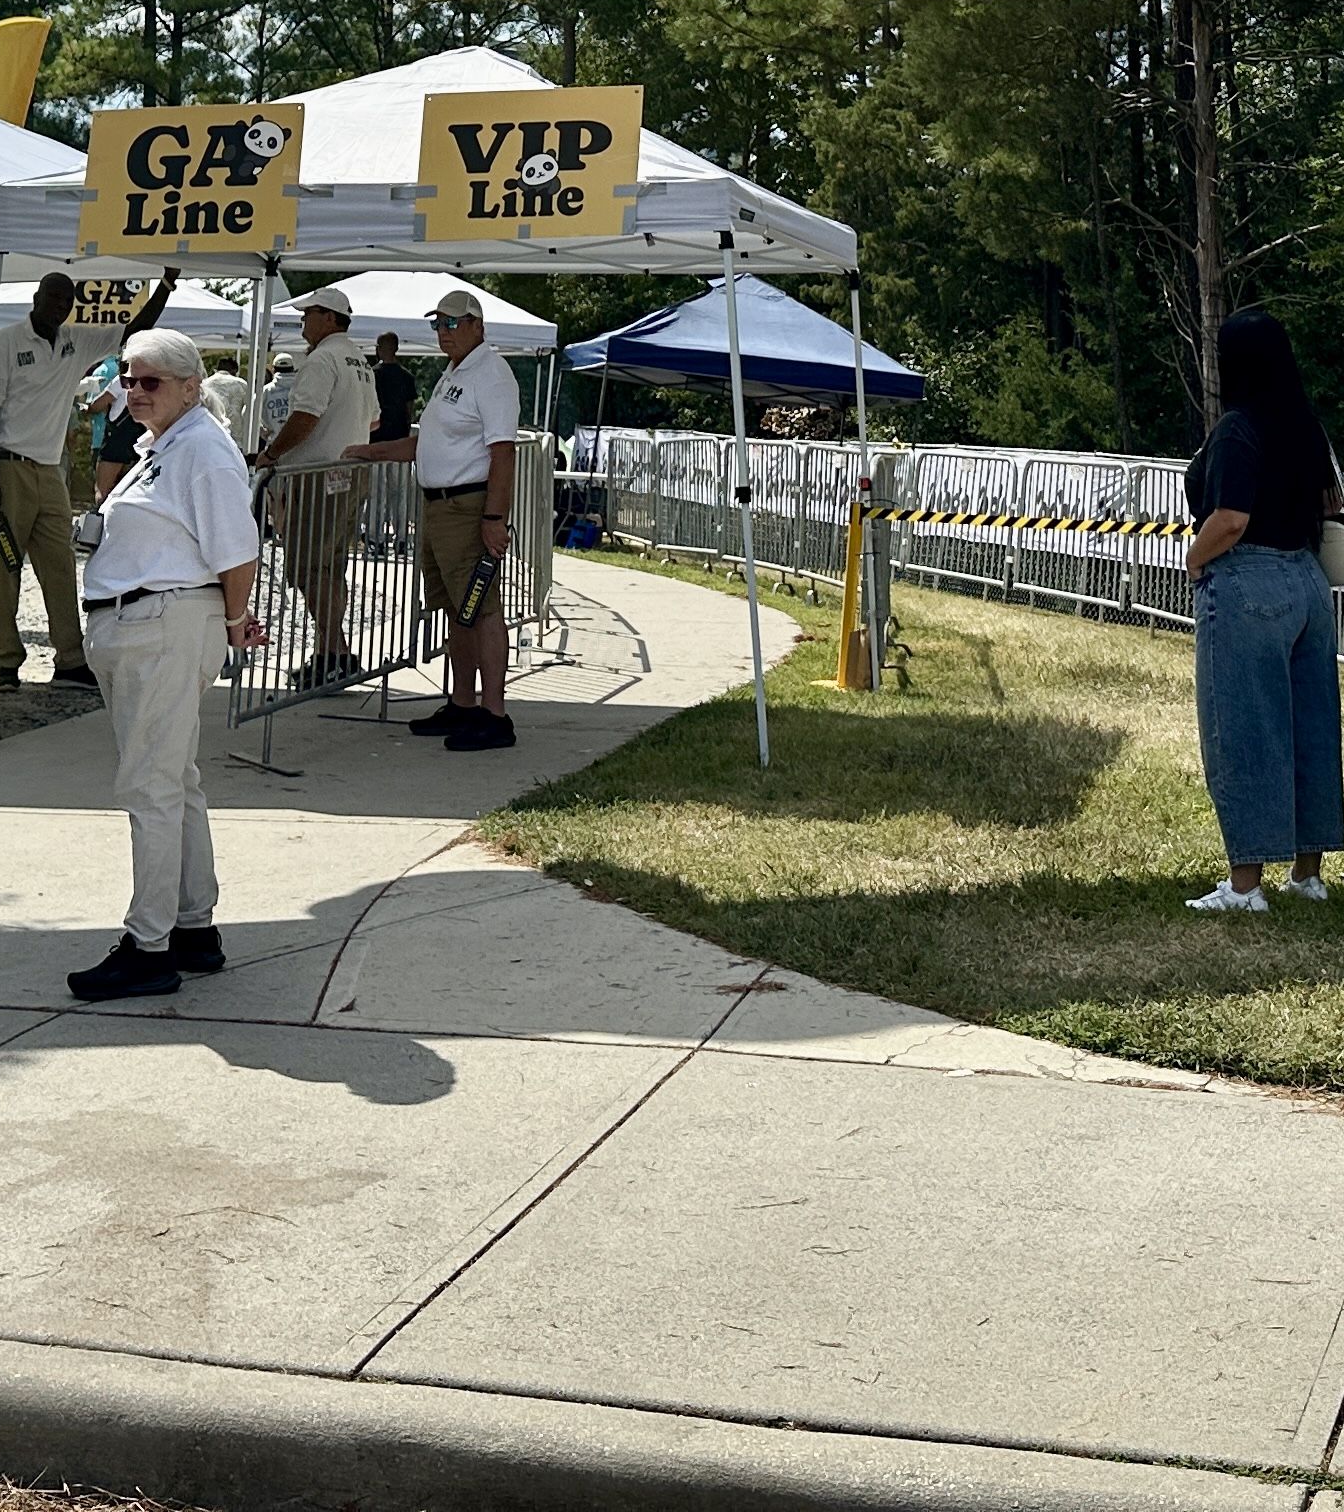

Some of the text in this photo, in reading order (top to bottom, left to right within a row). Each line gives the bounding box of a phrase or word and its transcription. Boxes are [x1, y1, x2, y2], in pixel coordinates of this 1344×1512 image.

[126, 124, 258, 191] GA
[447, 120, 613, 174] VIP
[122, 190, 254, 237] Line
[467, 178, 585, 219] Line
[74, 279, 133, 305] GA
[74, 305, 131, 325] Line
[272, 409, 289, 419] LIF
